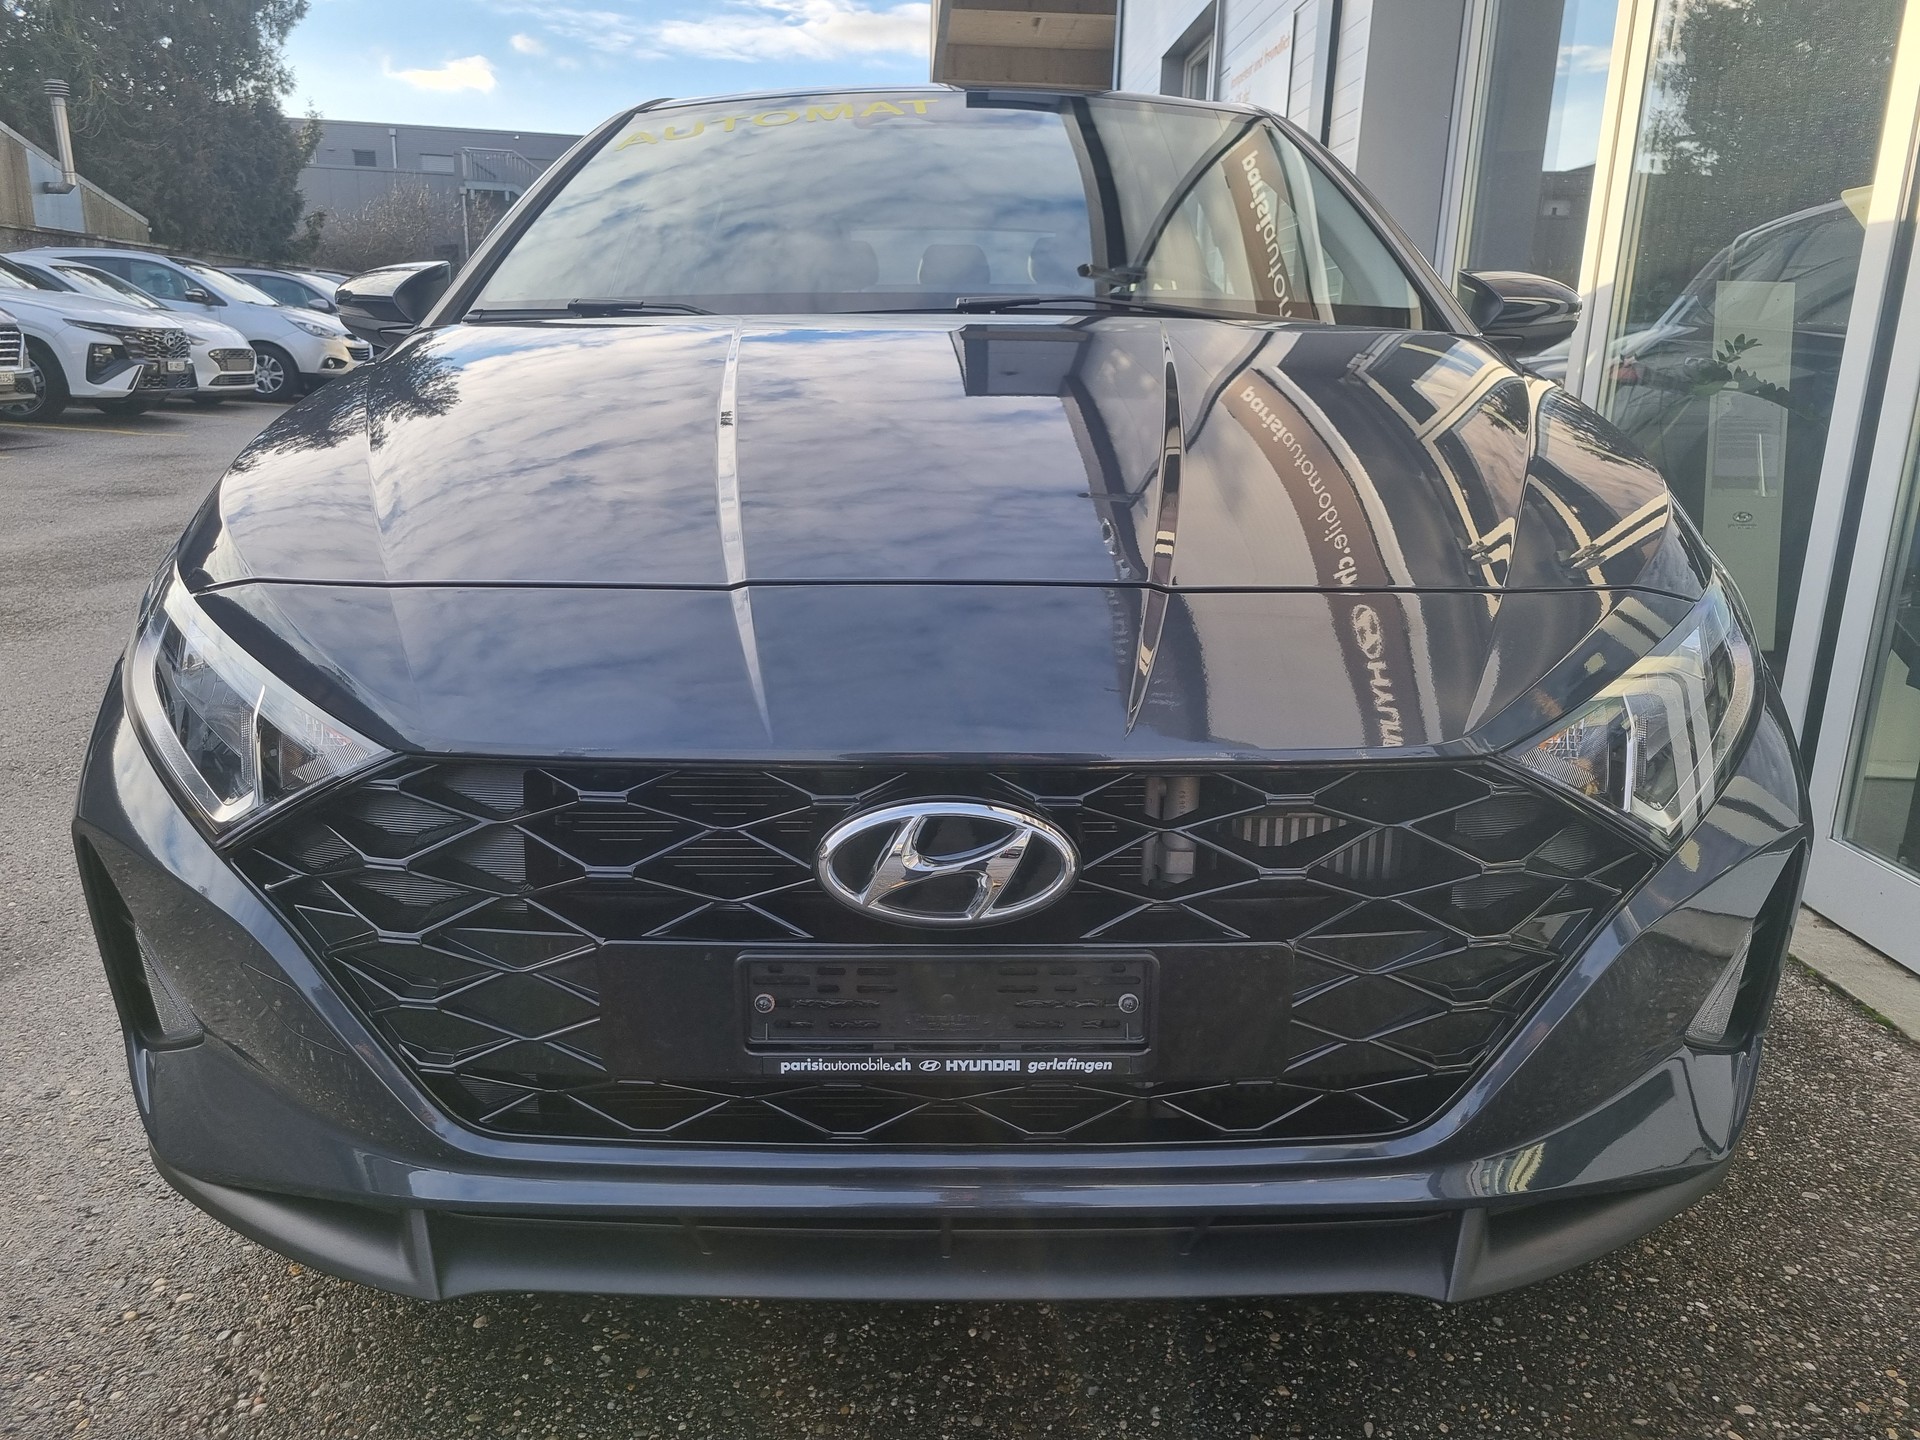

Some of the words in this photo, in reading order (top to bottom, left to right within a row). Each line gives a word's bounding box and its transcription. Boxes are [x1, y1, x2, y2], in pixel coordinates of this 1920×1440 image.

[614, 99, 939, 151] AUTOMAT
[780, 1057, 912, 1075] parisiautomobile.ch
[945, 1059, 1021, 1072] HYUNDAI
[1027, 1057, 1113, 1074] gerlafingen
